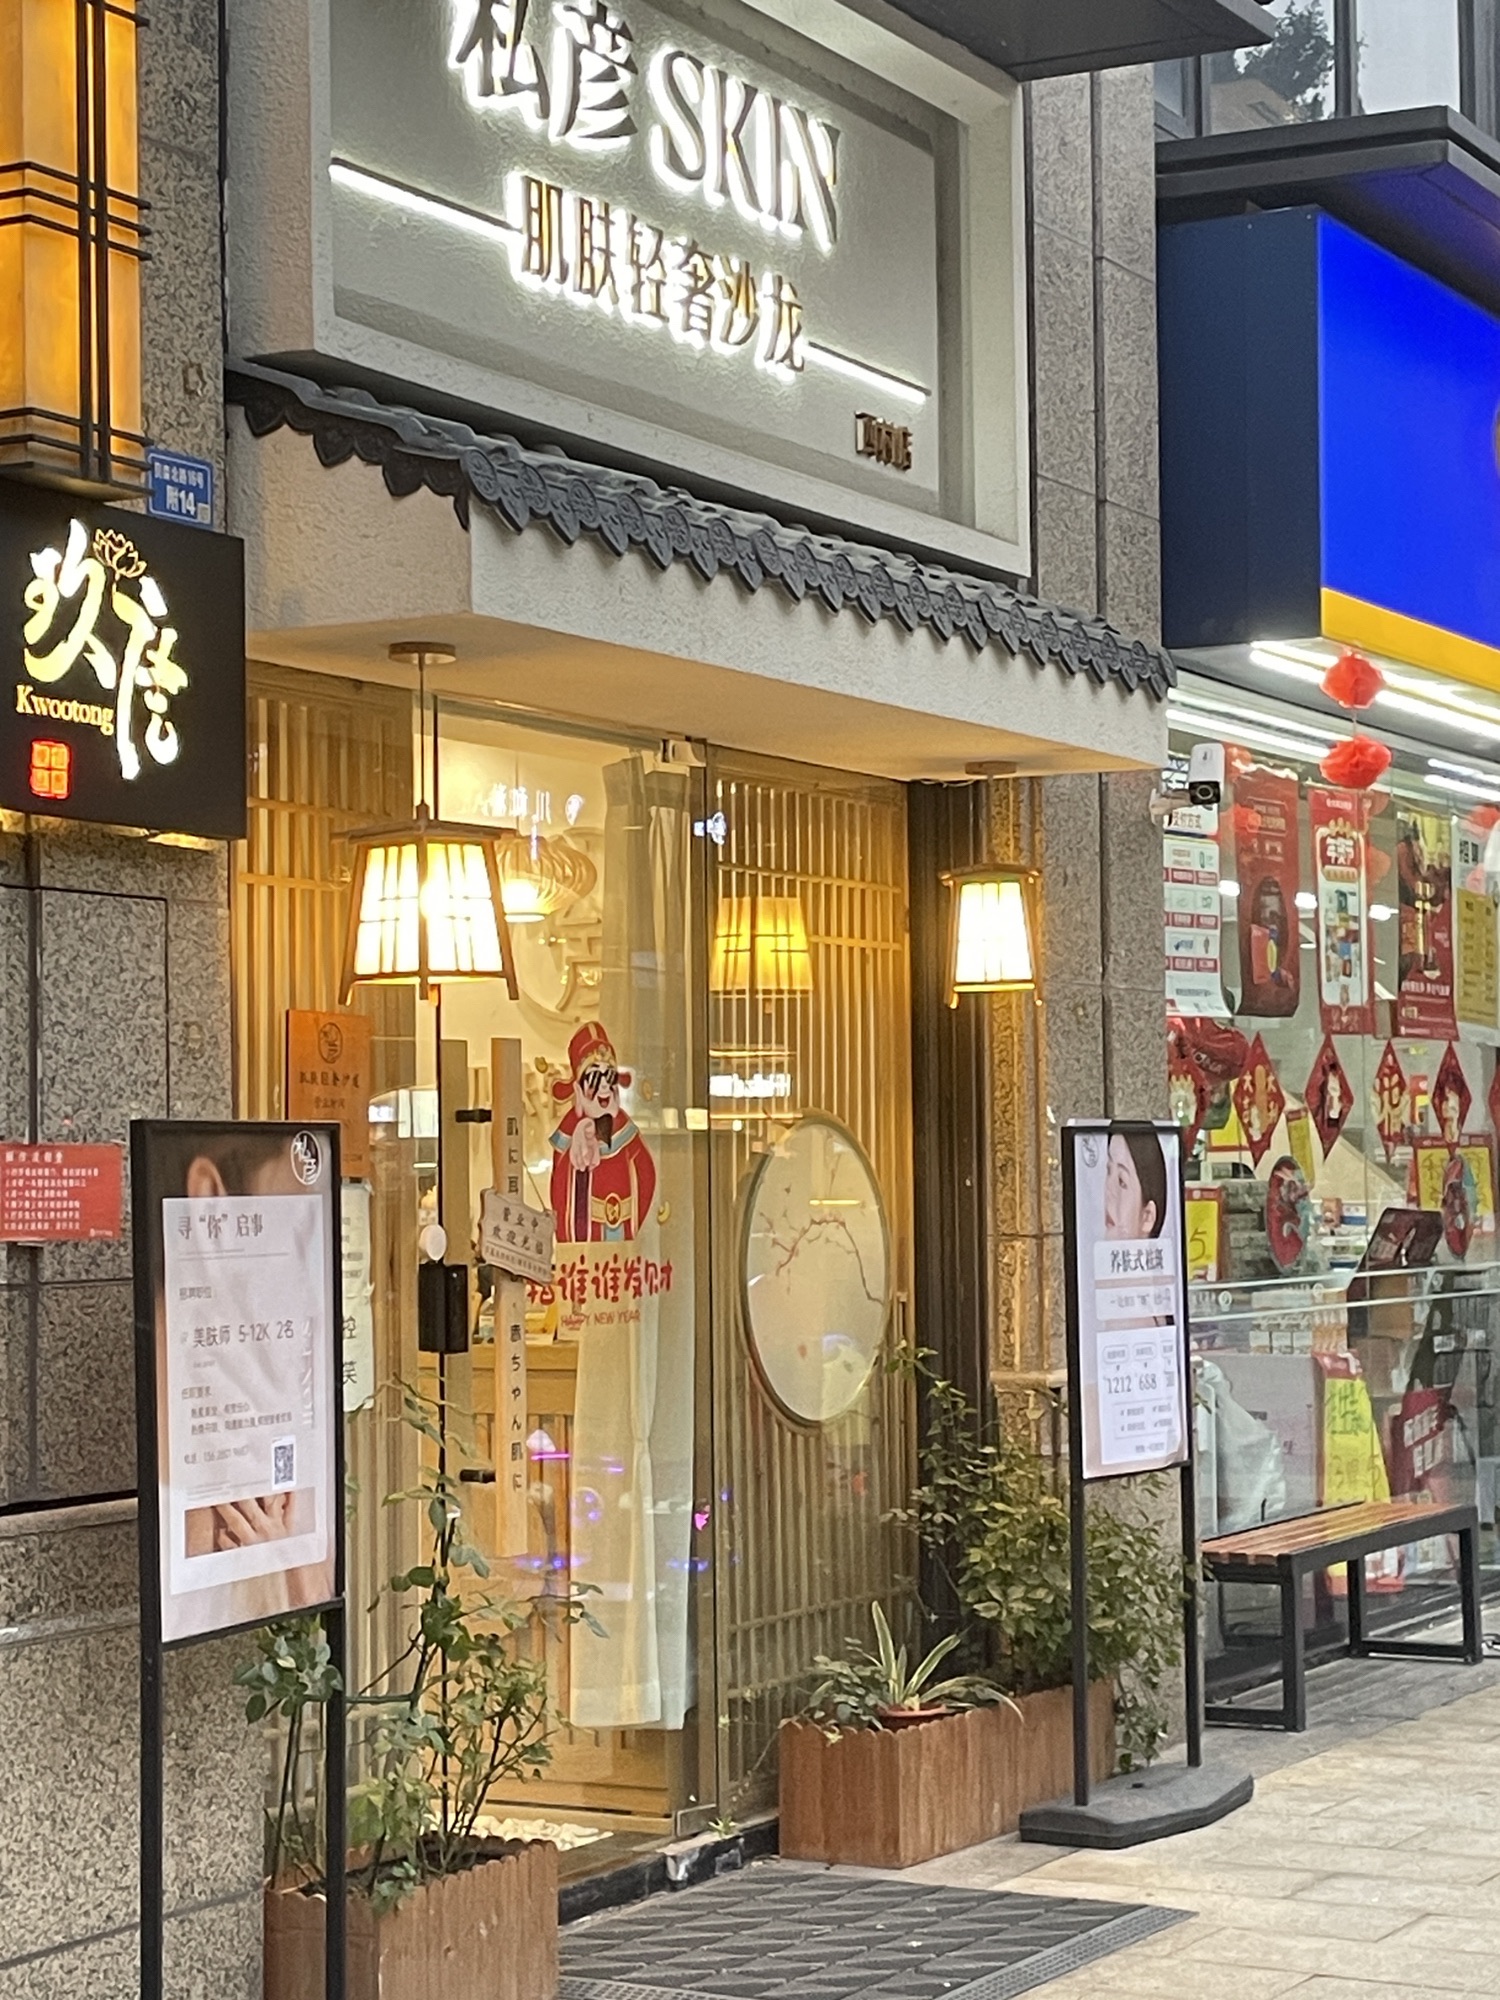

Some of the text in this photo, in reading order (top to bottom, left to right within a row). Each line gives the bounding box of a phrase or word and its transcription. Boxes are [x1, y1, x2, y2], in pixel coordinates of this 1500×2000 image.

[652, 47, 840, 252] SKIN
[514, 172, 806, 376] 肌肤轻奢沙龙
[16, 684, 115, 736] Kwootong
[193, 1323, 231, 1348] 美肤师
[276, 1318, 294, 1340] 2名
[560, 1308, 641, 1328] HAPPY NEW YEAR
